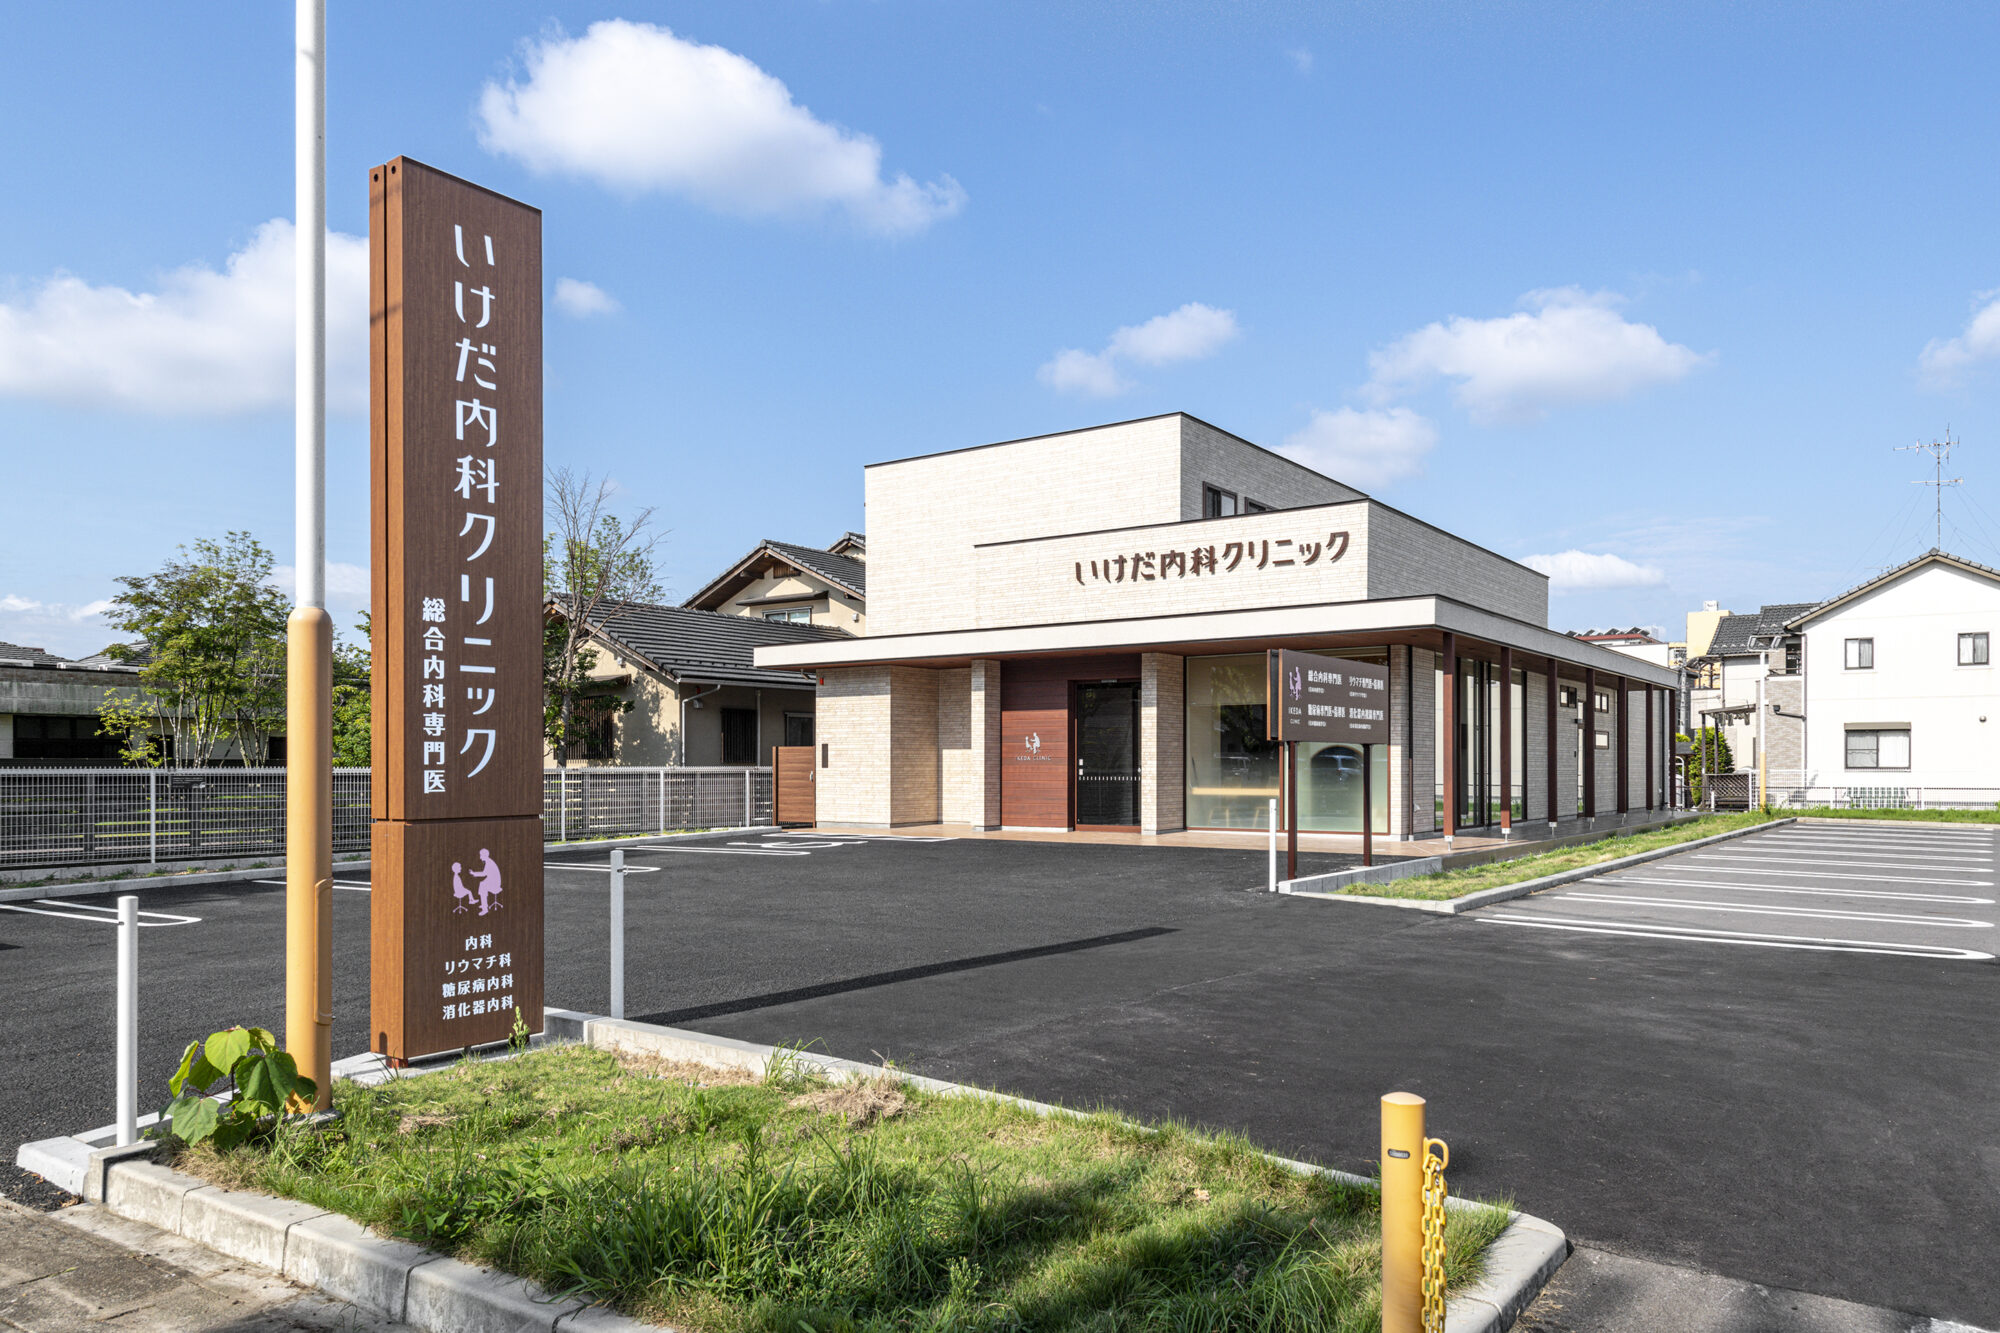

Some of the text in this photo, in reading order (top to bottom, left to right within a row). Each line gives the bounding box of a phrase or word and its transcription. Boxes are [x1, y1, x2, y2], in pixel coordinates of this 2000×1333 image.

[453, 223, 500, 779] いけだ内科クリニック
[1075, 531, 1350, 585] いけだ内科クリニック
[422, 597, 446, 794] 総合内科専門医
[465, 933, 493, 951] 内科
[445, 952, 512, 975] リウマチ科
[442, 973, 514, 998] 糖尿病内科
[442, 994, 514, 1021] 消化器内科
